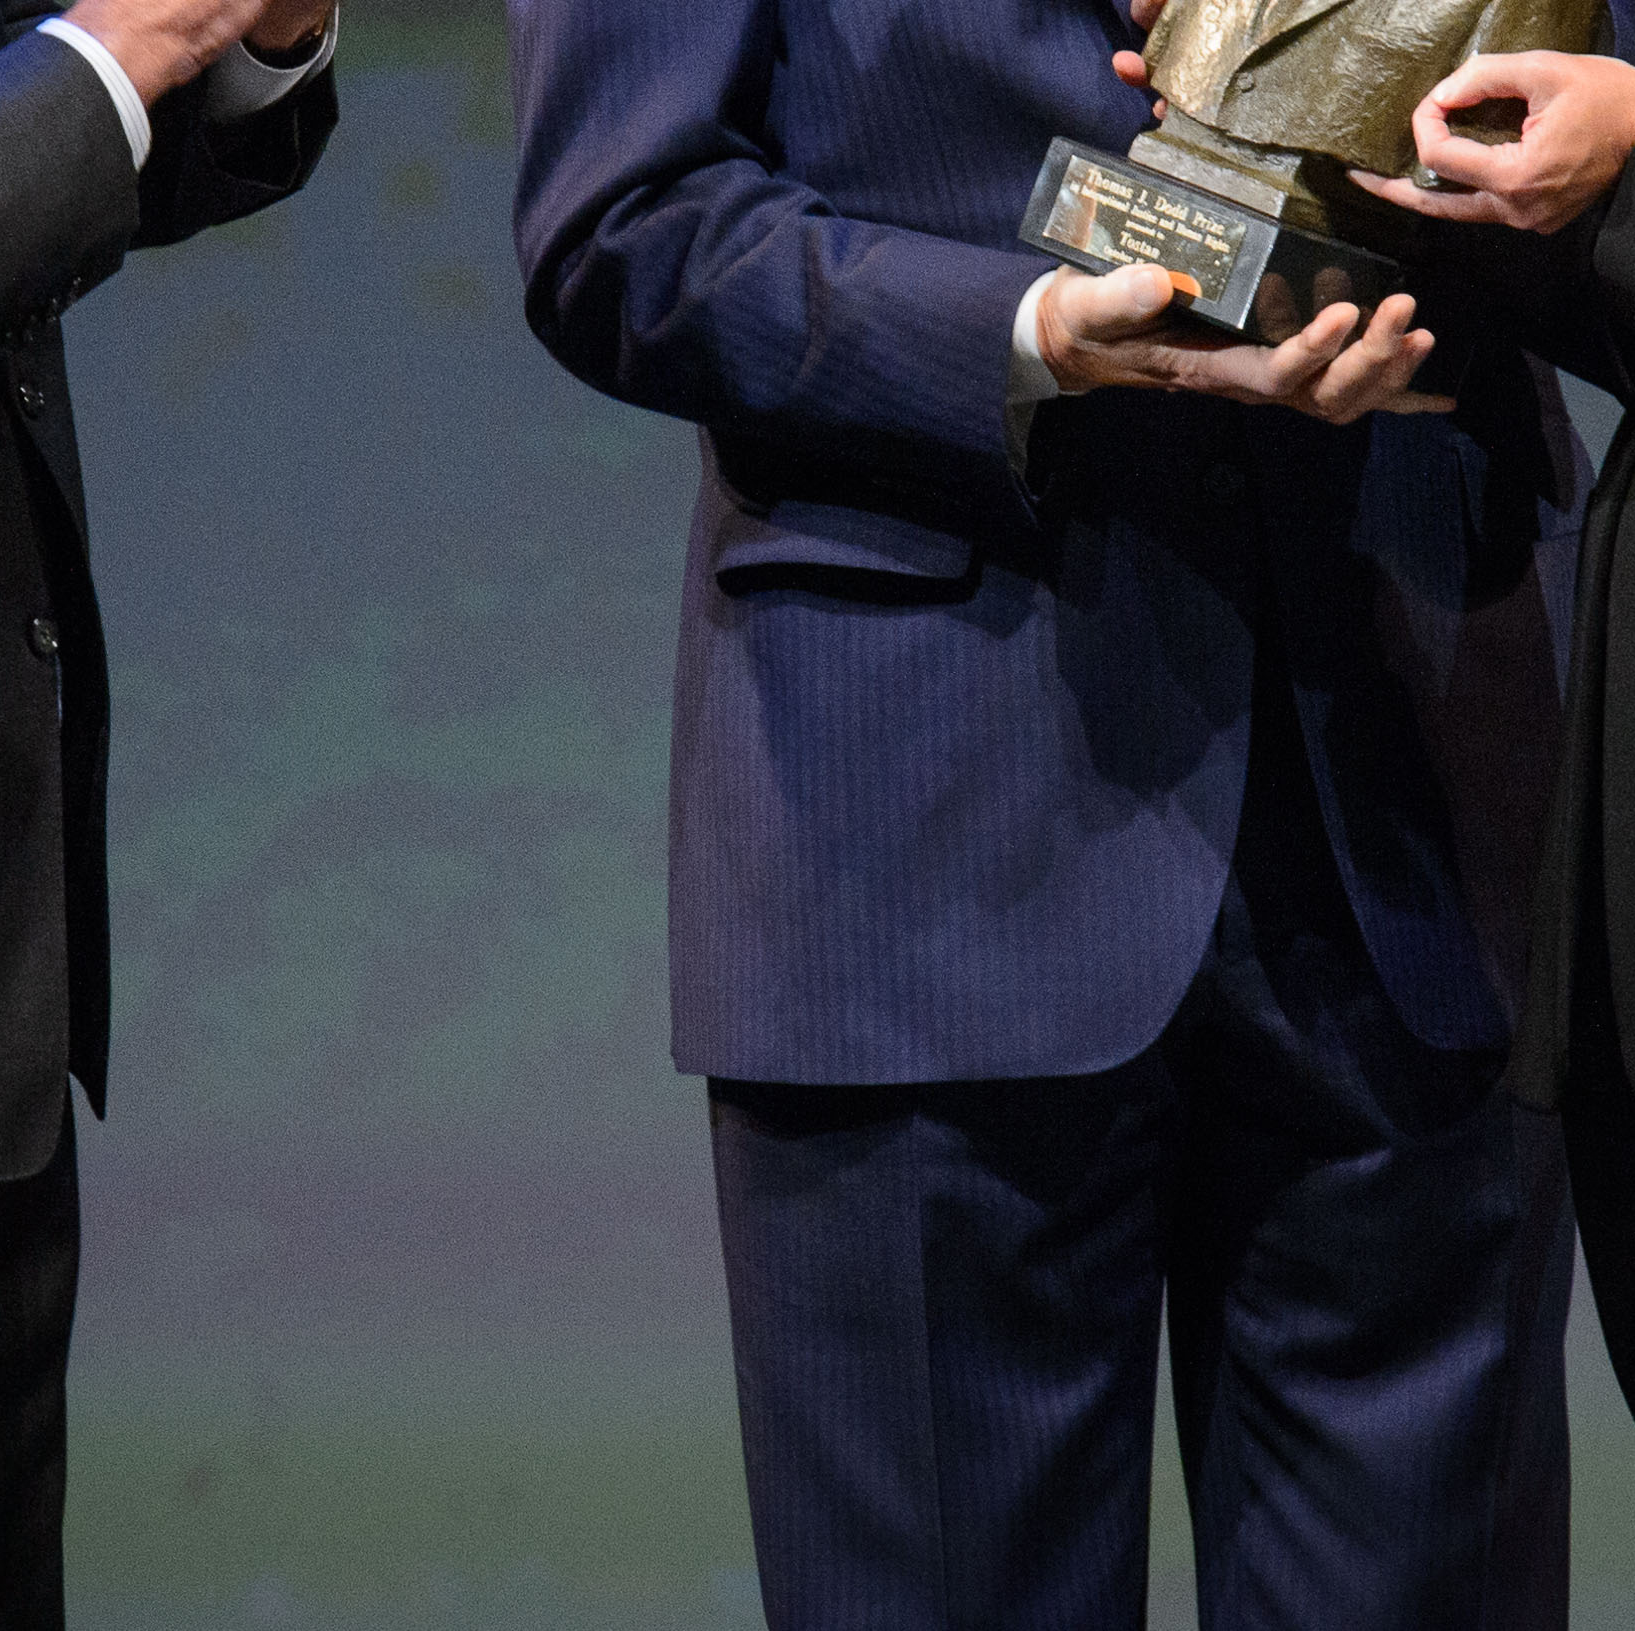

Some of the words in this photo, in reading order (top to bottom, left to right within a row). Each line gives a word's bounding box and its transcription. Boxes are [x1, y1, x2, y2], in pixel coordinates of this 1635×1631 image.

[1087, 168, 1134, 200] Thomas
[1137, 189, 1148, 206] J.
[1154, 196, 1189, 221] Dodd
[1192, 211, 1225, 236] Prize
[1120, 230, 1160, 259] Tostan
[1158, 218, 1175, 231] and
[1204, 234, 1231, 253] Rights
